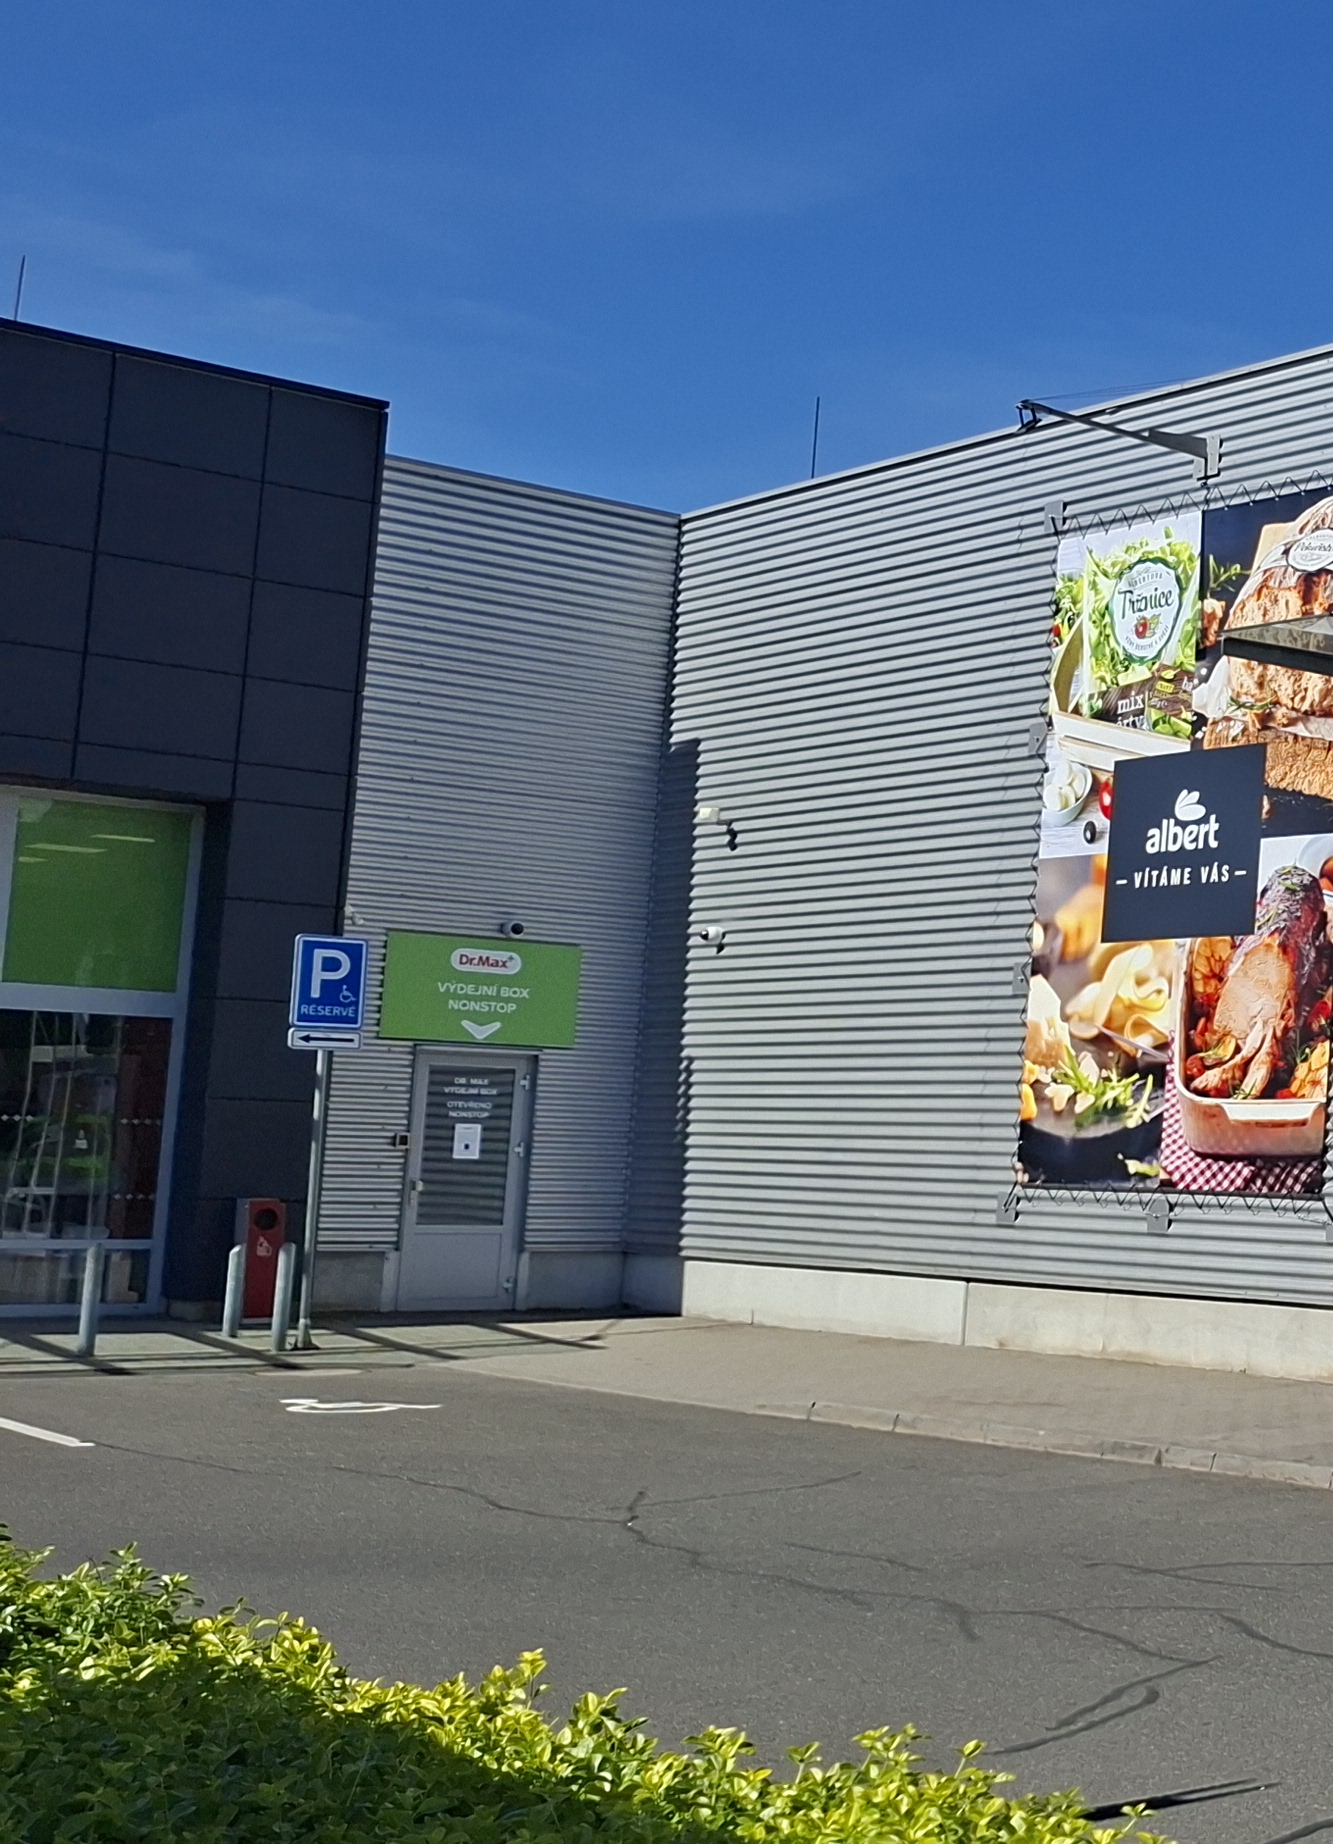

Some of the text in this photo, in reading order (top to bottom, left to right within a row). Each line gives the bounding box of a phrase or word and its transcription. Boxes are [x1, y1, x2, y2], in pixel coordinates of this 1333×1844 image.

[1117, 587, 1175, 620] Tržnice
[1117, 691, 1144, 714] mix
[1145, 813, 1220, 854] albert
[1134, 861, 1230, 889] VÍTÁME VÁS
[458, 953, 508, 969] Dr.Max
[310, 948, 351, 998] P
[438, 980, 531, 999] VÝDEJNÍ BOX
[300, 1004, 356, 1017] RÉSERVÉ
[448, 999, 517, 1014] NONSTOP
